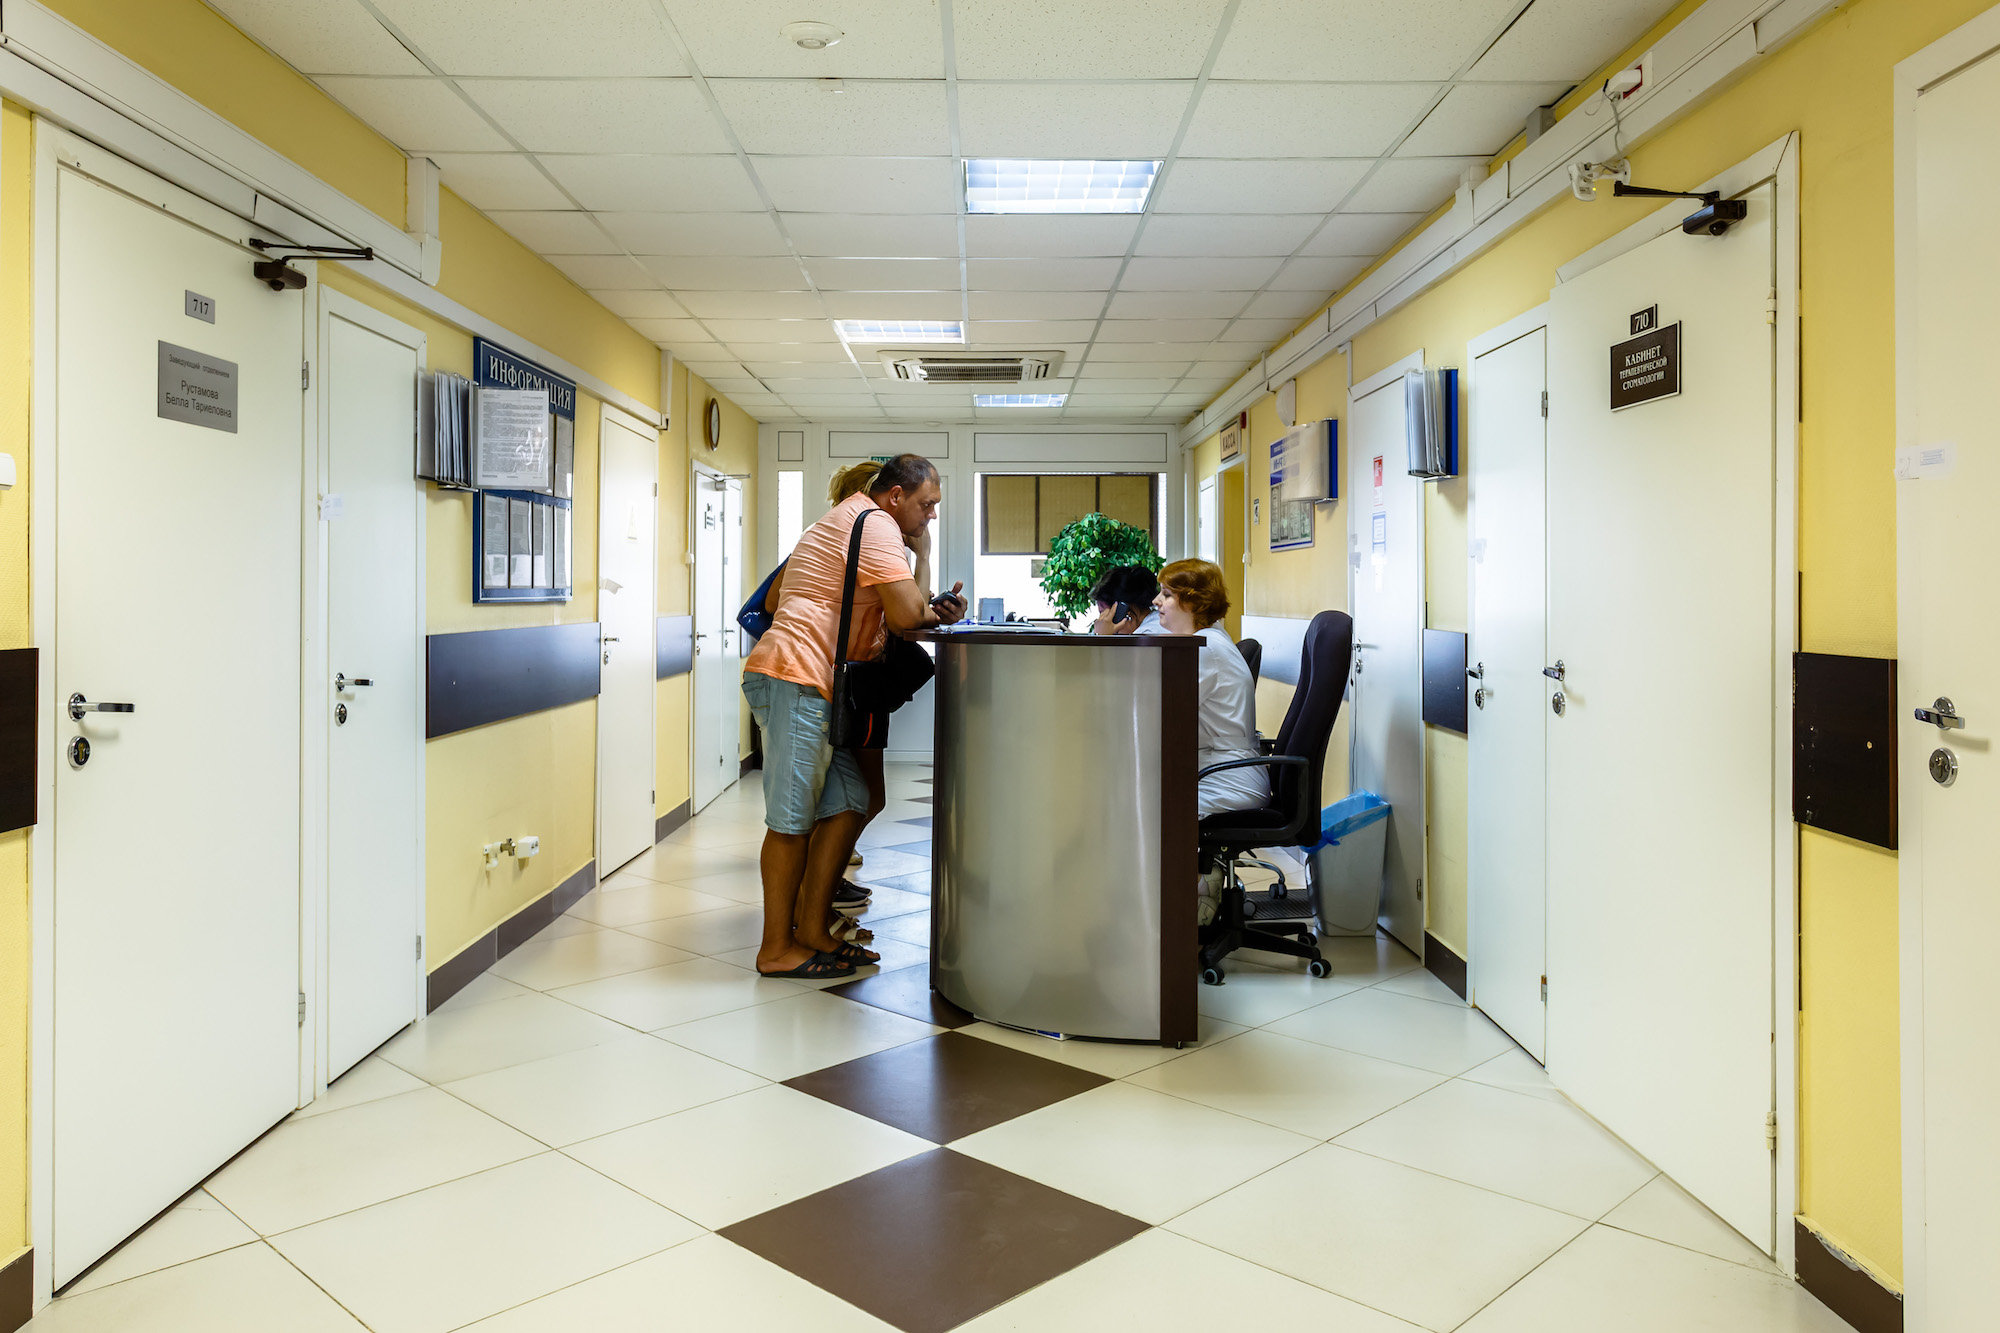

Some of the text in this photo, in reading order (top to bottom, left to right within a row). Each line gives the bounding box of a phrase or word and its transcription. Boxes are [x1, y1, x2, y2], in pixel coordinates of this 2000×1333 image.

[193, 298, 209, 316] 717
[1634, 312, 1649, 332] 710
[1625, 345, 1662, 367] КАБИНЕТ
[1619, 356, 1668, 380] ТЕРАПЕВТИЧЕСКОЙ
[181, 379, 219, 400] Рустамова
[1622, 370, 1665, 391] СТОМАТОЛОГИИ
[165, 392, 232, 418] Белла Тариеловна
